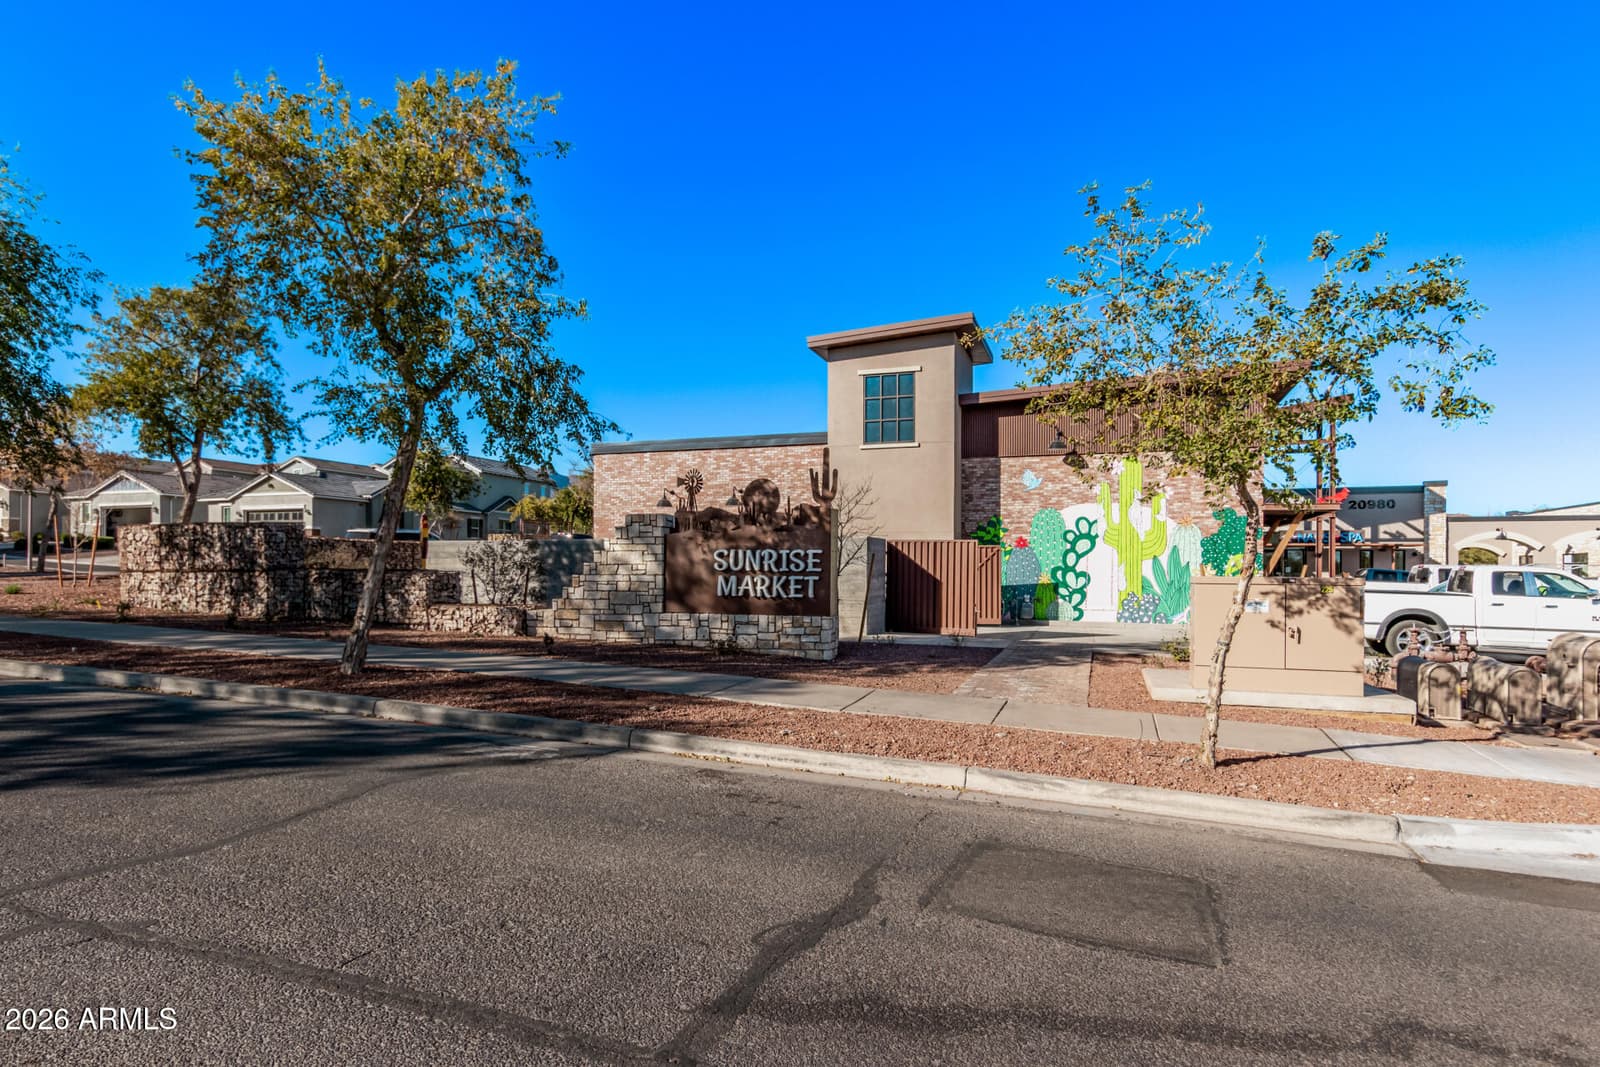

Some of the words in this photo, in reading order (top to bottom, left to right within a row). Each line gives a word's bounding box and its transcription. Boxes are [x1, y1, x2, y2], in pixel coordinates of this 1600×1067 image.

[1348, 499, 1396, 510] 20980
[1341, 532, 1364, 543] SPA
[713, 549, 823, 573] SUNRISE
[716, 575, 819, 599] MARKET
